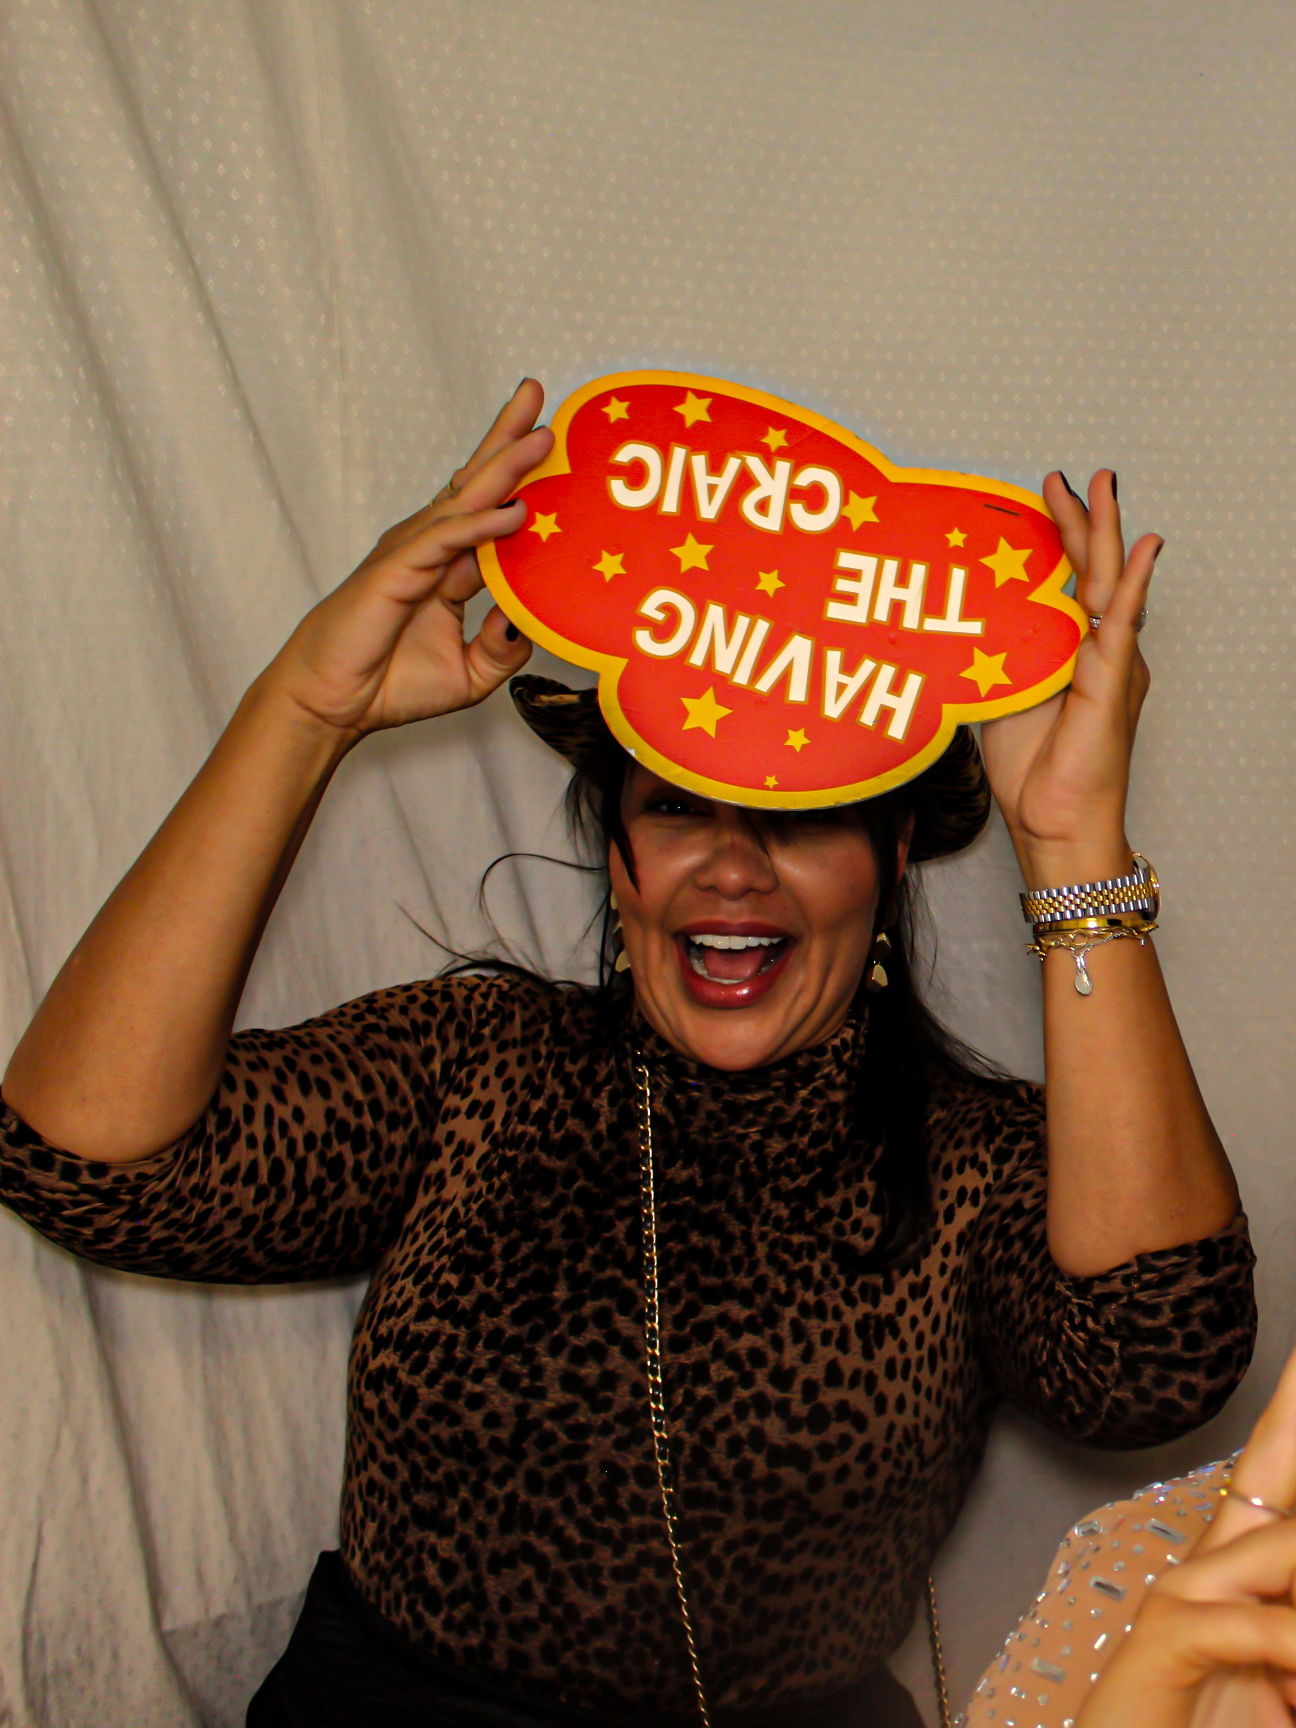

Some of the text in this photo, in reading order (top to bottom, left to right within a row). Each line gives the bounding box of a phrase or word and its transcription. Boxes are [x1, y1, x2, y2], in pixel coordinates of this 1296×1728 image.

[609, 443, 842, 532] CRAIC
[824, 550, 984, 635] THE
[634, 588, 923, 741] HAVING
